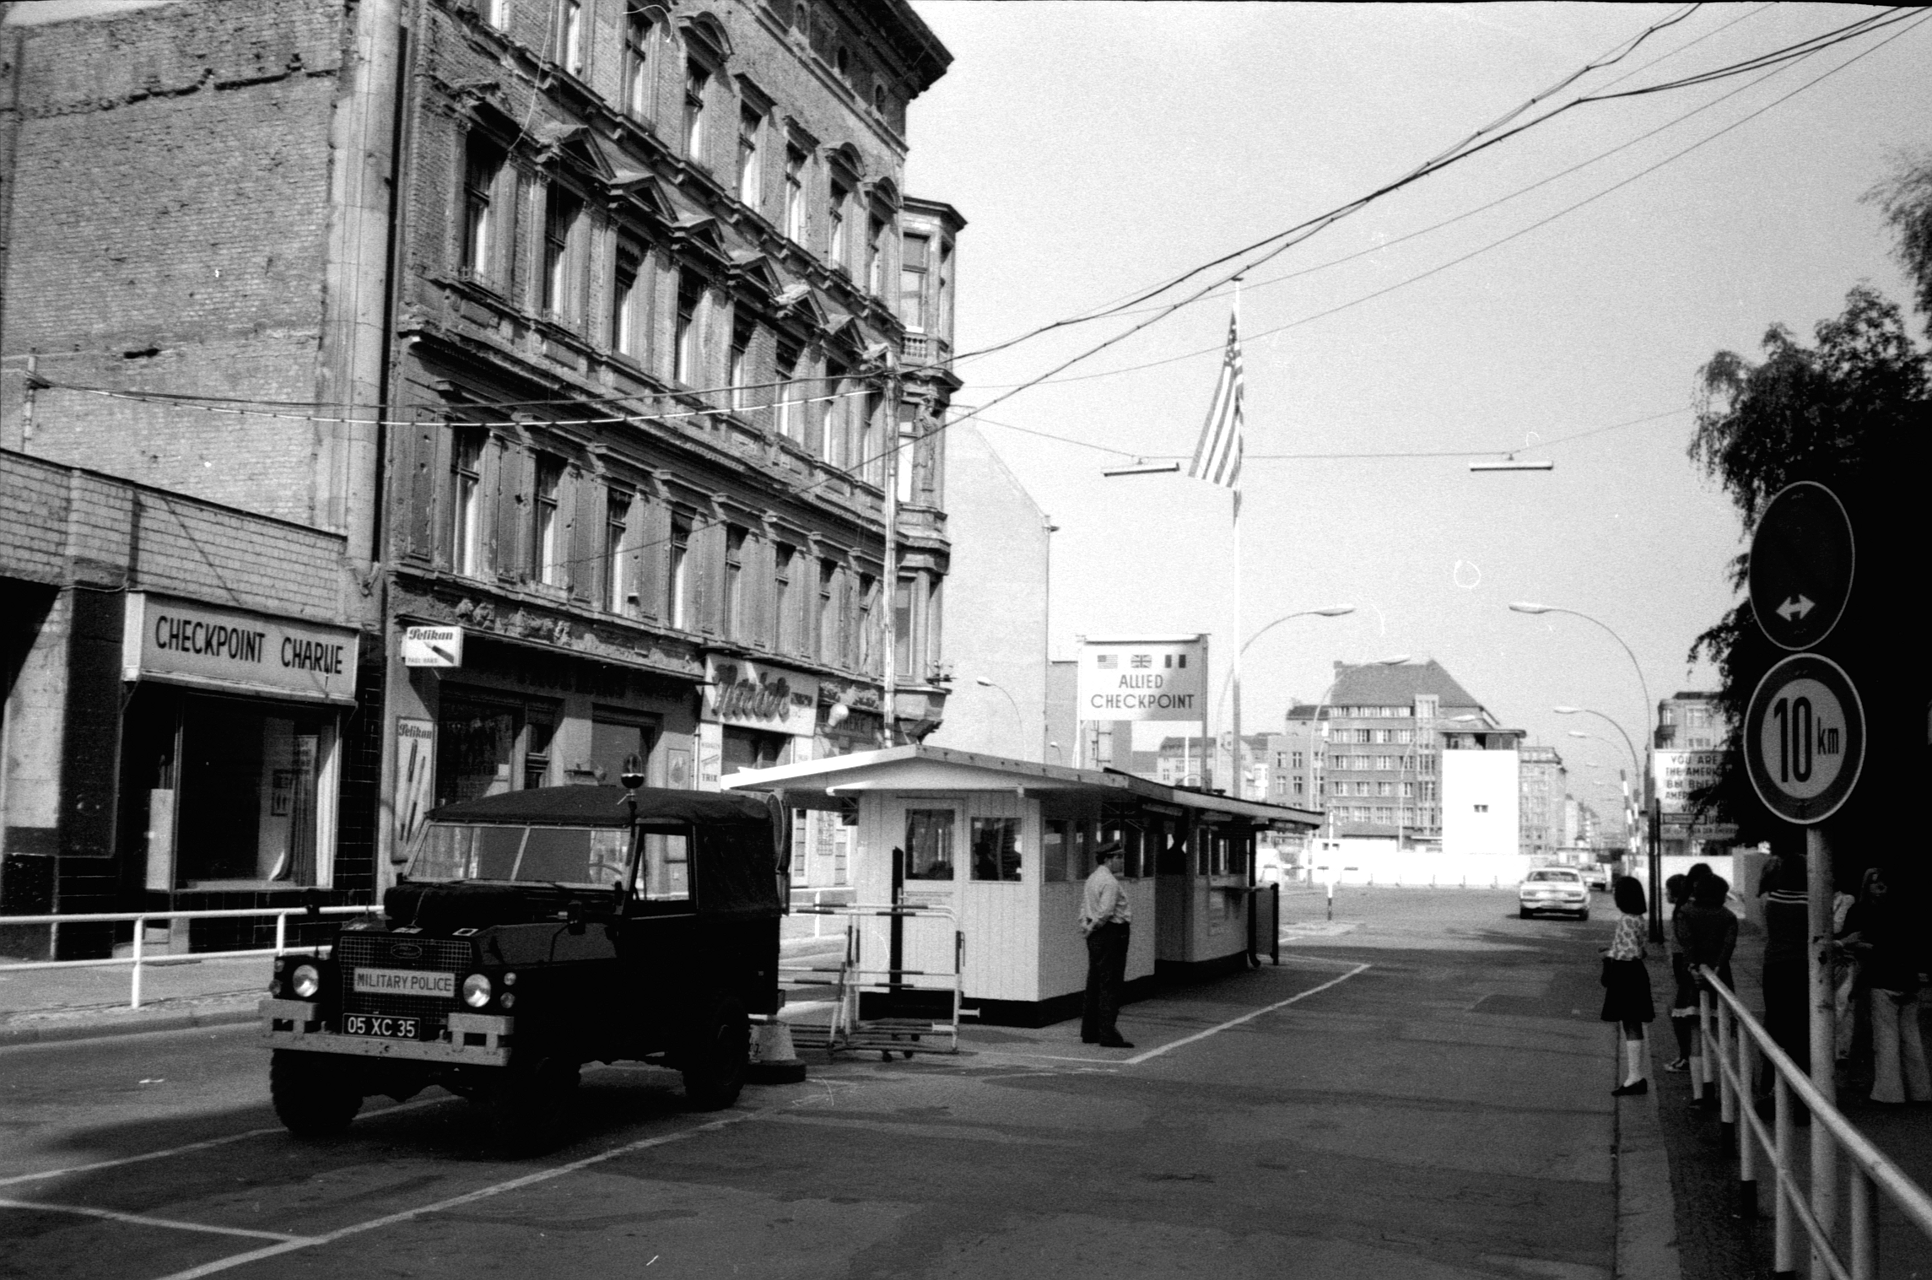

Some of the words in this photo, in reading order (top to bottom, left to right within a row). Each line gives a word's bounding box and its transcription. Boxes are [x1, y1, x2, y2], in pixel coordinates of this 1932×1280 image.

[408, 628, 454, 641] Pelikan
[155, 614, 266, 664] CHECKPOINT
[281, 636, 344, 675] CHARLIE
[1118, 674, 1164, 689] ALLIED
[1090, 693, 1195, 709] CHECKPOINT
[398, 723, 433, 739] Pelikan
[1773, 696, 1812, 784] 10
[1817, 716, 1839, 756] km
[1670, 755, 1691, 765] YOU
[1697, 755, 1718, 765] ARE
[702, 773, 718, 783] TRIX
[1665, 767, 1683, 776] THE
[357, 973, 408, 990] MILITARY
[411, 976, 452, 991] POLICE
[347, 1016, 366, 1034] 05
[371, 1018, 393, 1036] XC
[397, 1020, 415, 1037] 35
